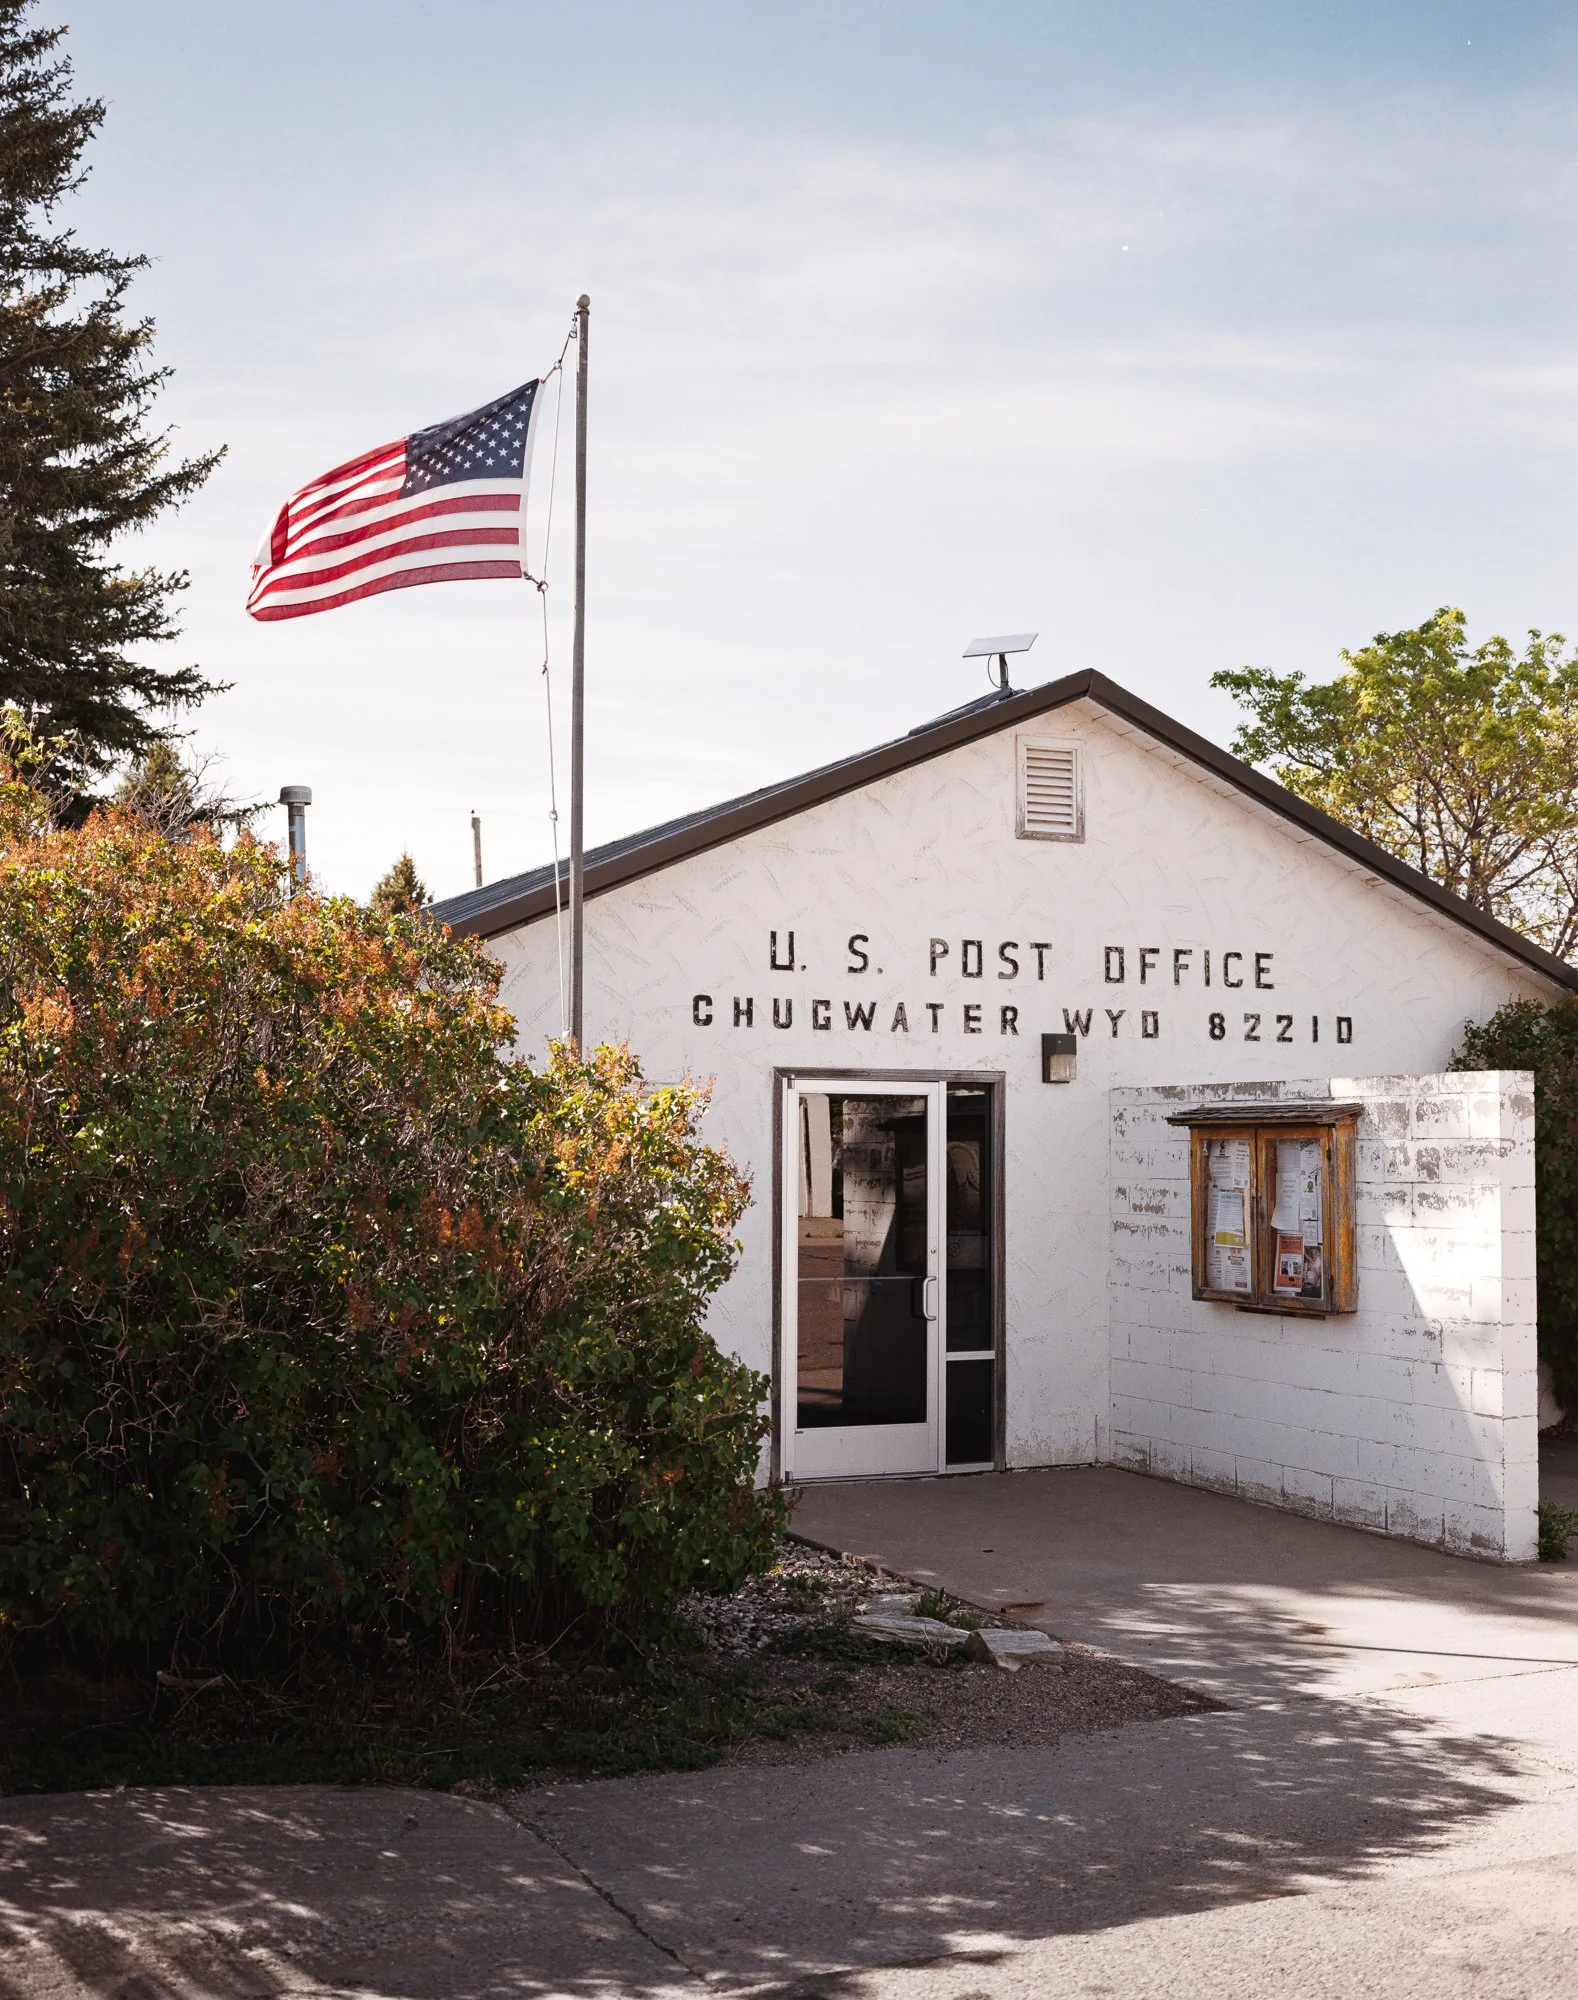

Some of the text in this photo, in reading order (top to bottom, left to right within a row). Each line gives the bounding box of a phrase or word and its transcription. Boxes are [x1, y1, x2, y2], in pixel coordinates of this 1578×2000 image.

[770, 930, 1275, 990] U. S. POST OFFICE
[692, 994, 1353, 1044] CHUGWATER WYO 82210
